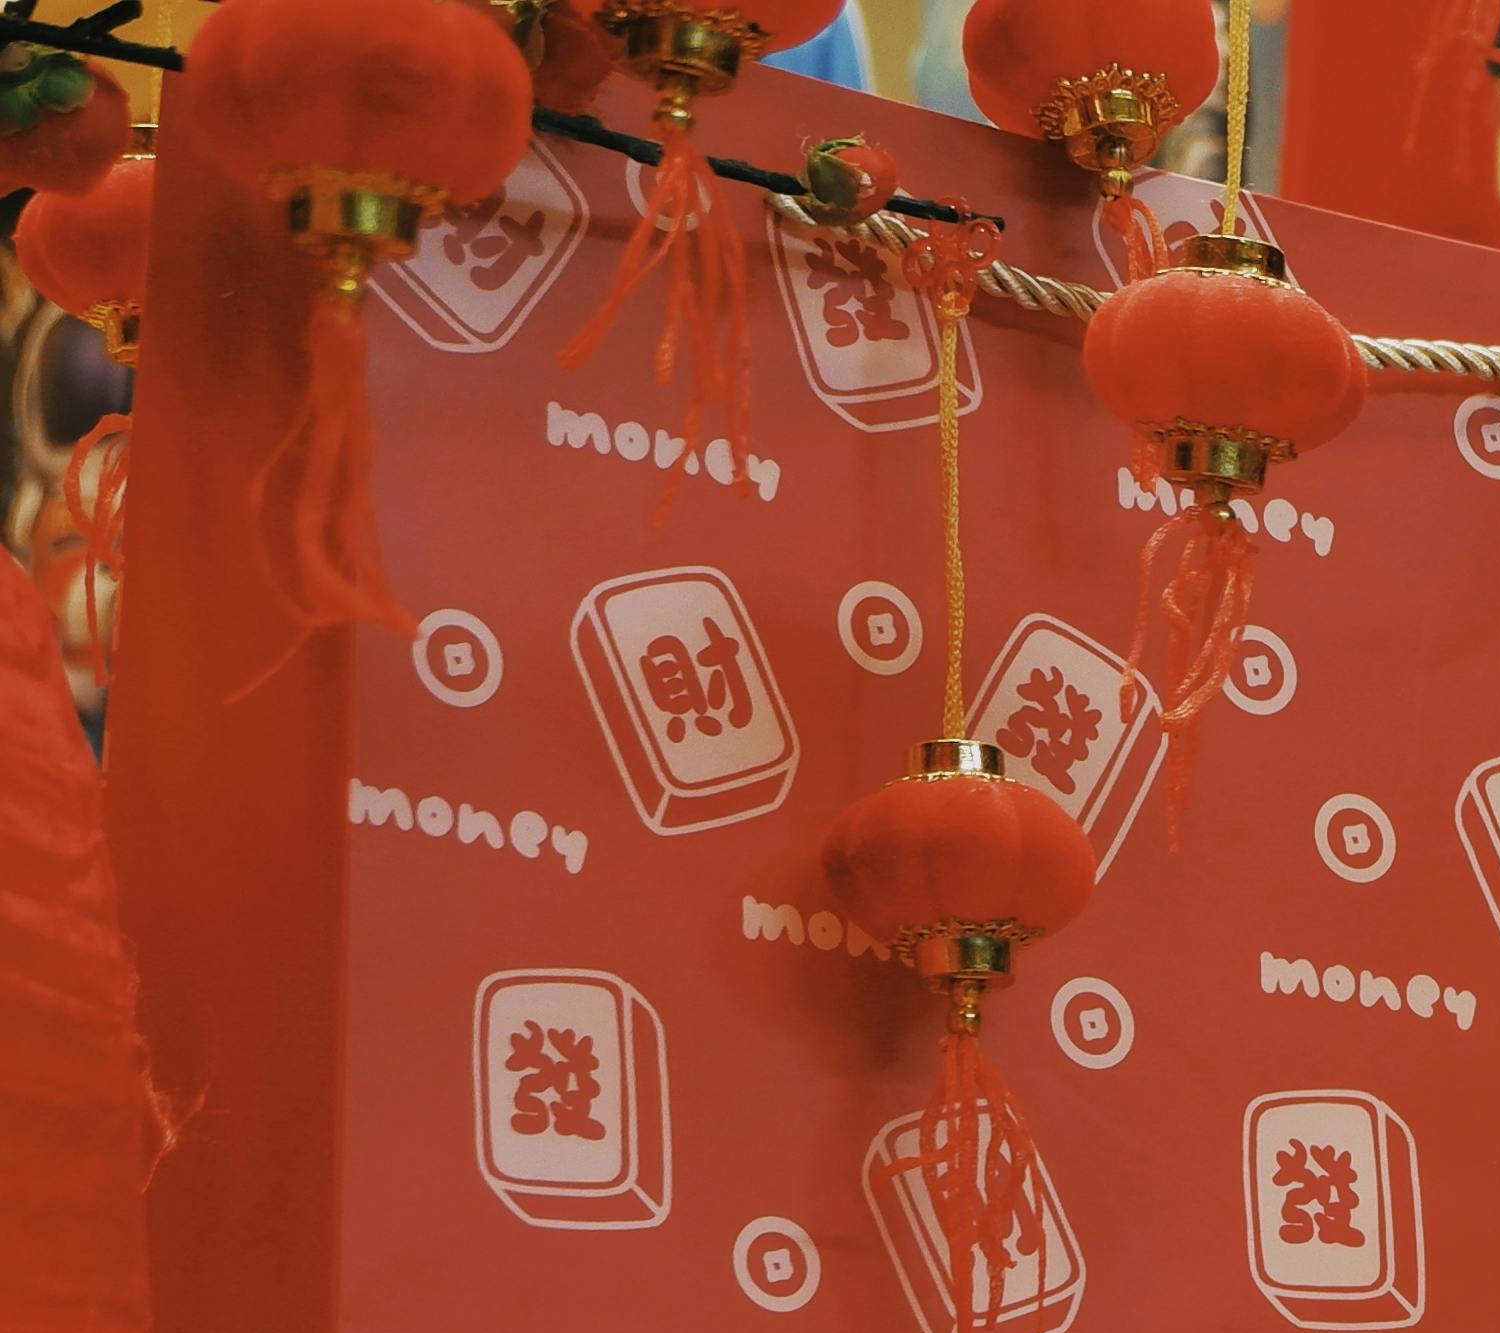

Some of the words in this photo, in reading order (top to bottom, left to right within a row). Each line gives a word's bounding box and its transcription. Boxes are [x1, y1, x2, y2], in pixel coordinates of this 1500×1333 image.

[804, 237, 910, 348] 發
[545, 400, 782, 502] money
[1116, 466, 1335, 557] mney
[640, 617, 753, 743] 財
[995, 666, 1101, 794] 發
[347, 777, 589, 875] money
[742, 895, 890, 961] mon
[1259, 950, 1477, 1031] money
[505, 1021, 605, 1140] 發
[1273, 1139, 1365, 1247] 發
